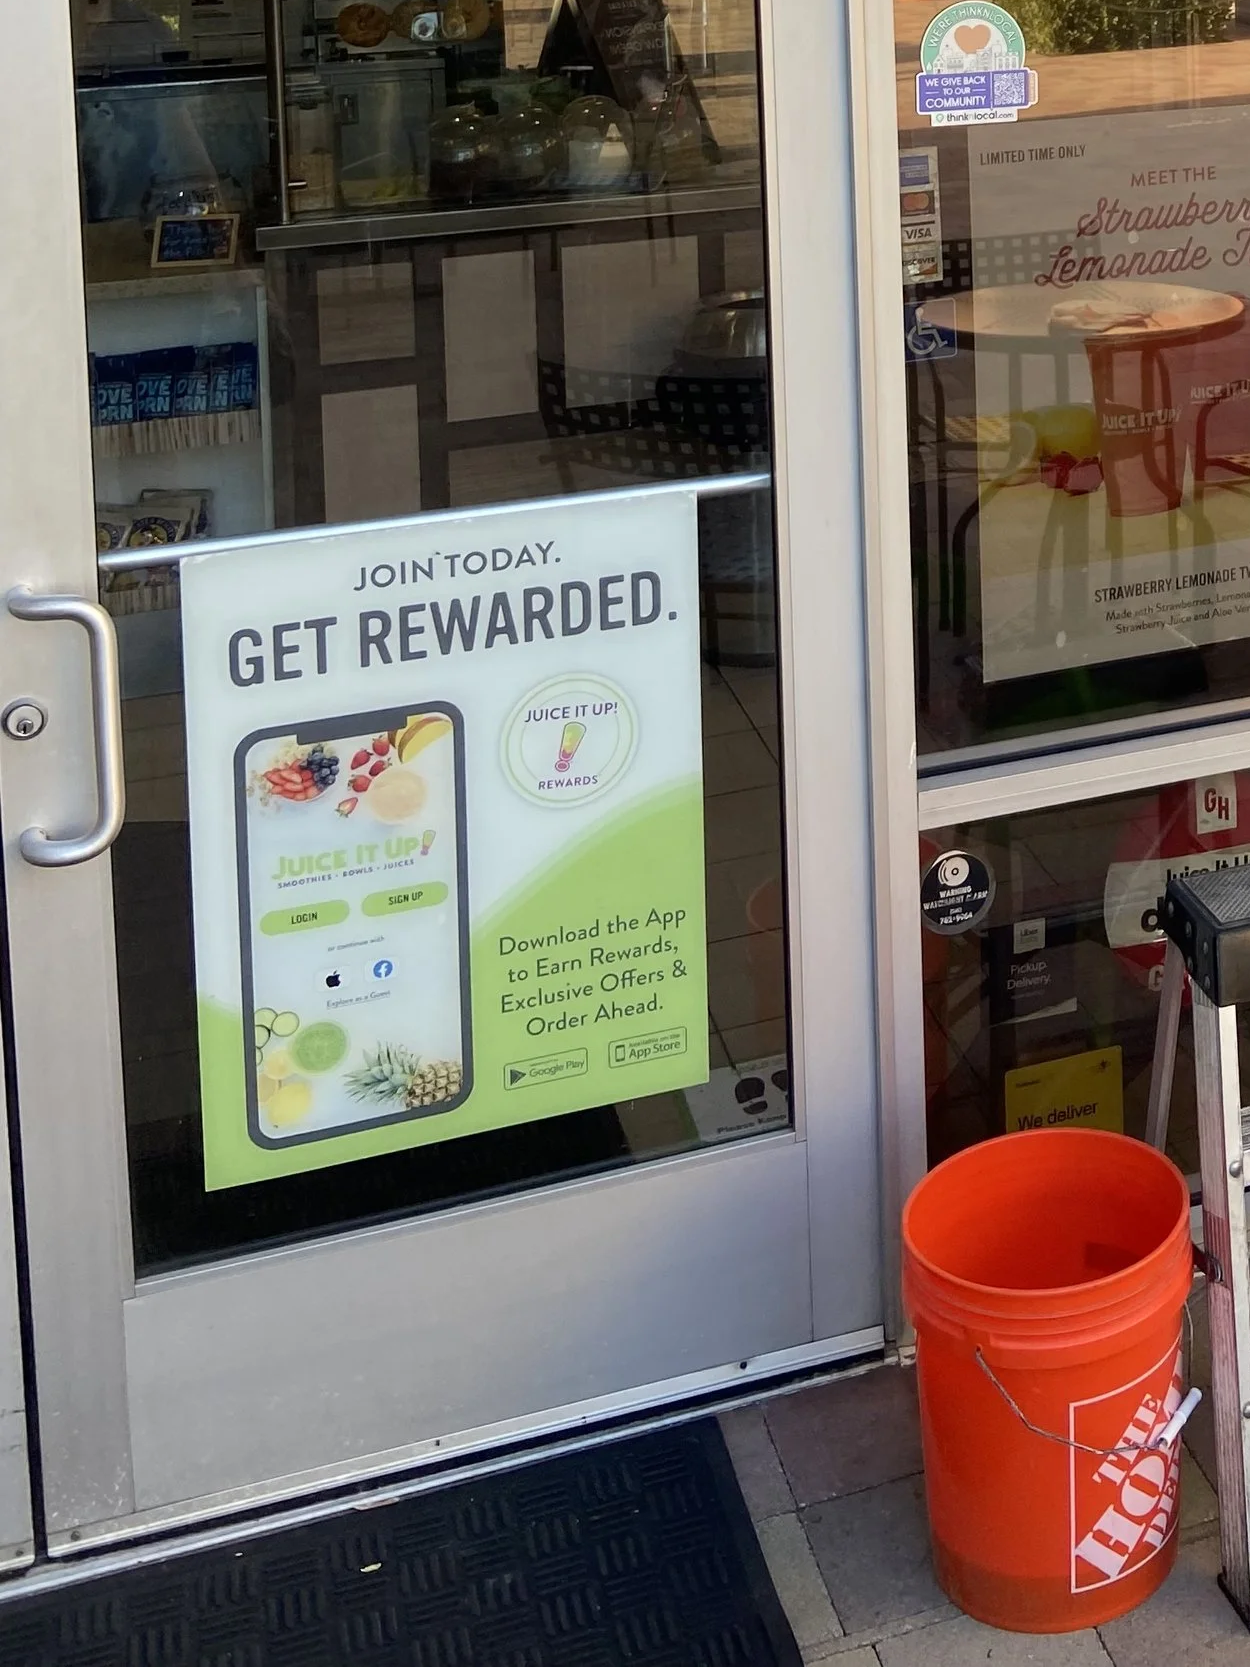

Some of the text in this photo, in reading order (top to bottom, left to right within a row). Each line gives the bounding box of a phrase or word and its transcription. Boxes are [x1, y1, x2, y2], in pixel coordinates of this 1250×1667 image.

[927, 6, 1017, 48] WE'RE THINKNLOCAL
[925, 75, 986, 87] WE GIVE BACK
[943, 87, 971, 96] TO OUR
[925, 96, 987, 109] COMMUNITY
[980, 145, 1087, 166] LIMITED TIME ONLY
[1130, 166, 1217, 188] MEET THE
[904, 228, 932, 239] VISA
[1034, 237, 1211, 289] Lemonade
[97, 387, 133, 405] OVE
[137, 380, 172, 396] OVE
[176, 378, 208, 395] OVE
[1102, 413, 1136, 430] JUICE
[1140, 411, 1154, 426] IT
[353, 541, 562, 591] JOIN TODAY.
[1094, 578, 1173, 603] STRAWBERRY
[1175, 567, 1236, 590] LEMONADE
[1106, 609, 1132, 622] Made
[1155, 597, 1215, 613] Strawberries,
[1115, 618, 1166, 635] Strawberry
[1168, 613, 1192, 626] Juice
[1193, 610, 1210, 621] and
[1211, 605, 1233, 619] Aloe
[228, 570, 678, 687] GET REWARDED.
[524, 702, 618, 723] JUICE IT UP!
[538, 775, 598, 790] REWARDS
[1203, 787, 1230, 821] GH
[272, 829, 436, 880] JUICE IT UP!
[277, 859, 414, 889] SMOOTHIES BOWLS JUICES
[388, 891, 423, 906] SIGN UP
[939, 885, 972, 898] WARNING
[291, 911, 318, 925] LOGIN
[499, 908, 686, 956] Download the App
[508, 935, 678, 983] to Earn Rewards,
[501, 959, 688, 1014] Exclusive Offers &
[526, 992, 664, 1036] Order Ahead.
[628, 1039, 681, 1060] App Store
[529, 1062, 564, 1079] Google
[565, 1059, 585, 1071] Play
[1017, 1102, 1098, 1131] We deliver
[1092, 1393, 1161, 1486] THE
